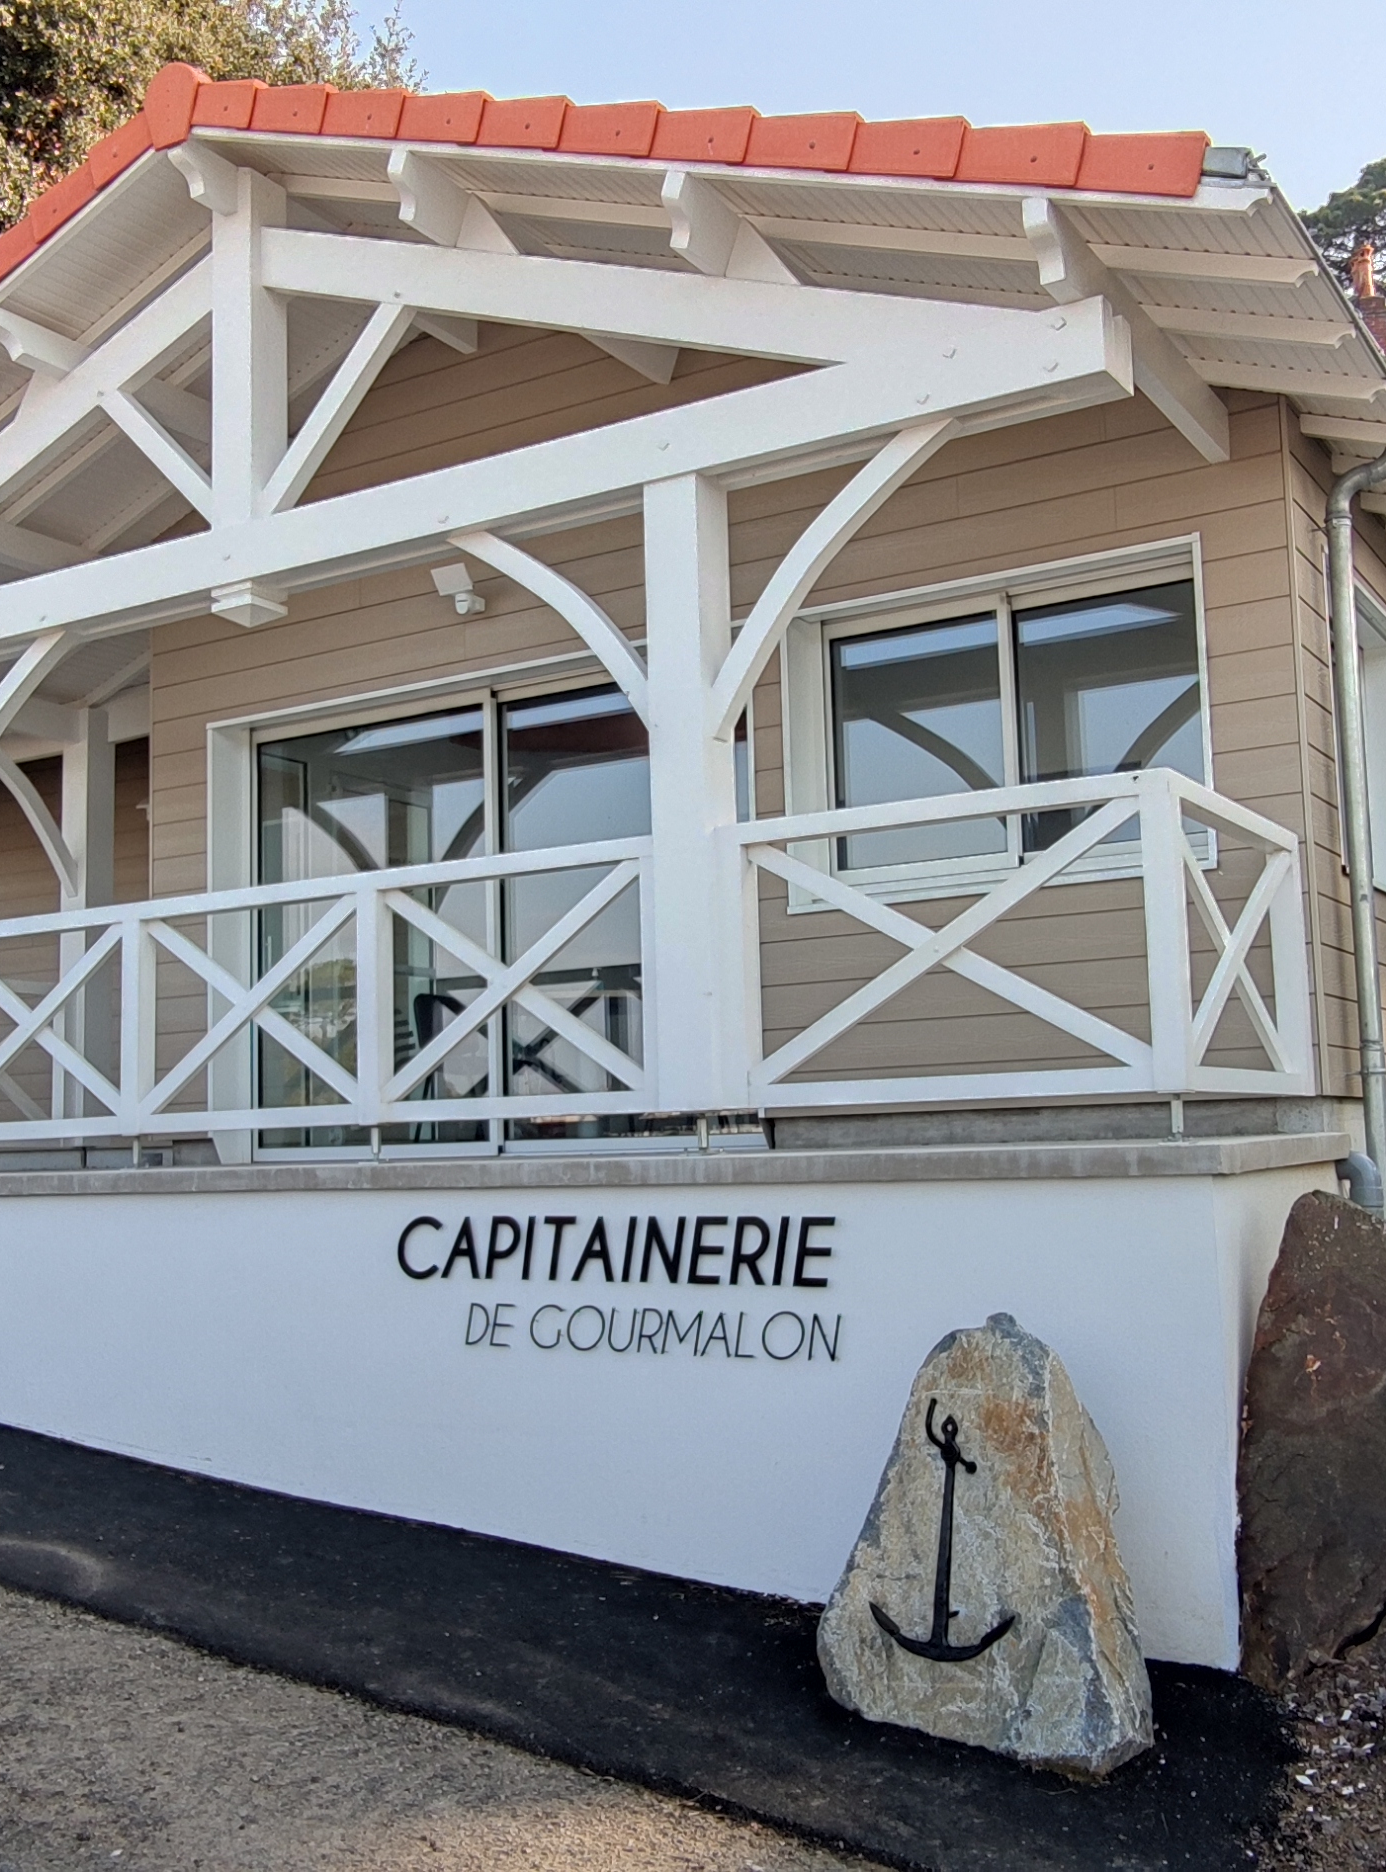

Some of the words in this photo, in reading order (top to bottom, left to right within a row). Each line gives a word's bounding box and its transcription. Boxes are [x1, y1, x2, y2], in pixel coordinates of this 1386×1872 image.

[397, 1215, 836, 1288] CAPITAINERIE
[464, 1302, 515, 1348] DE
[529, 1303, 842, 1362] GOURMALON
